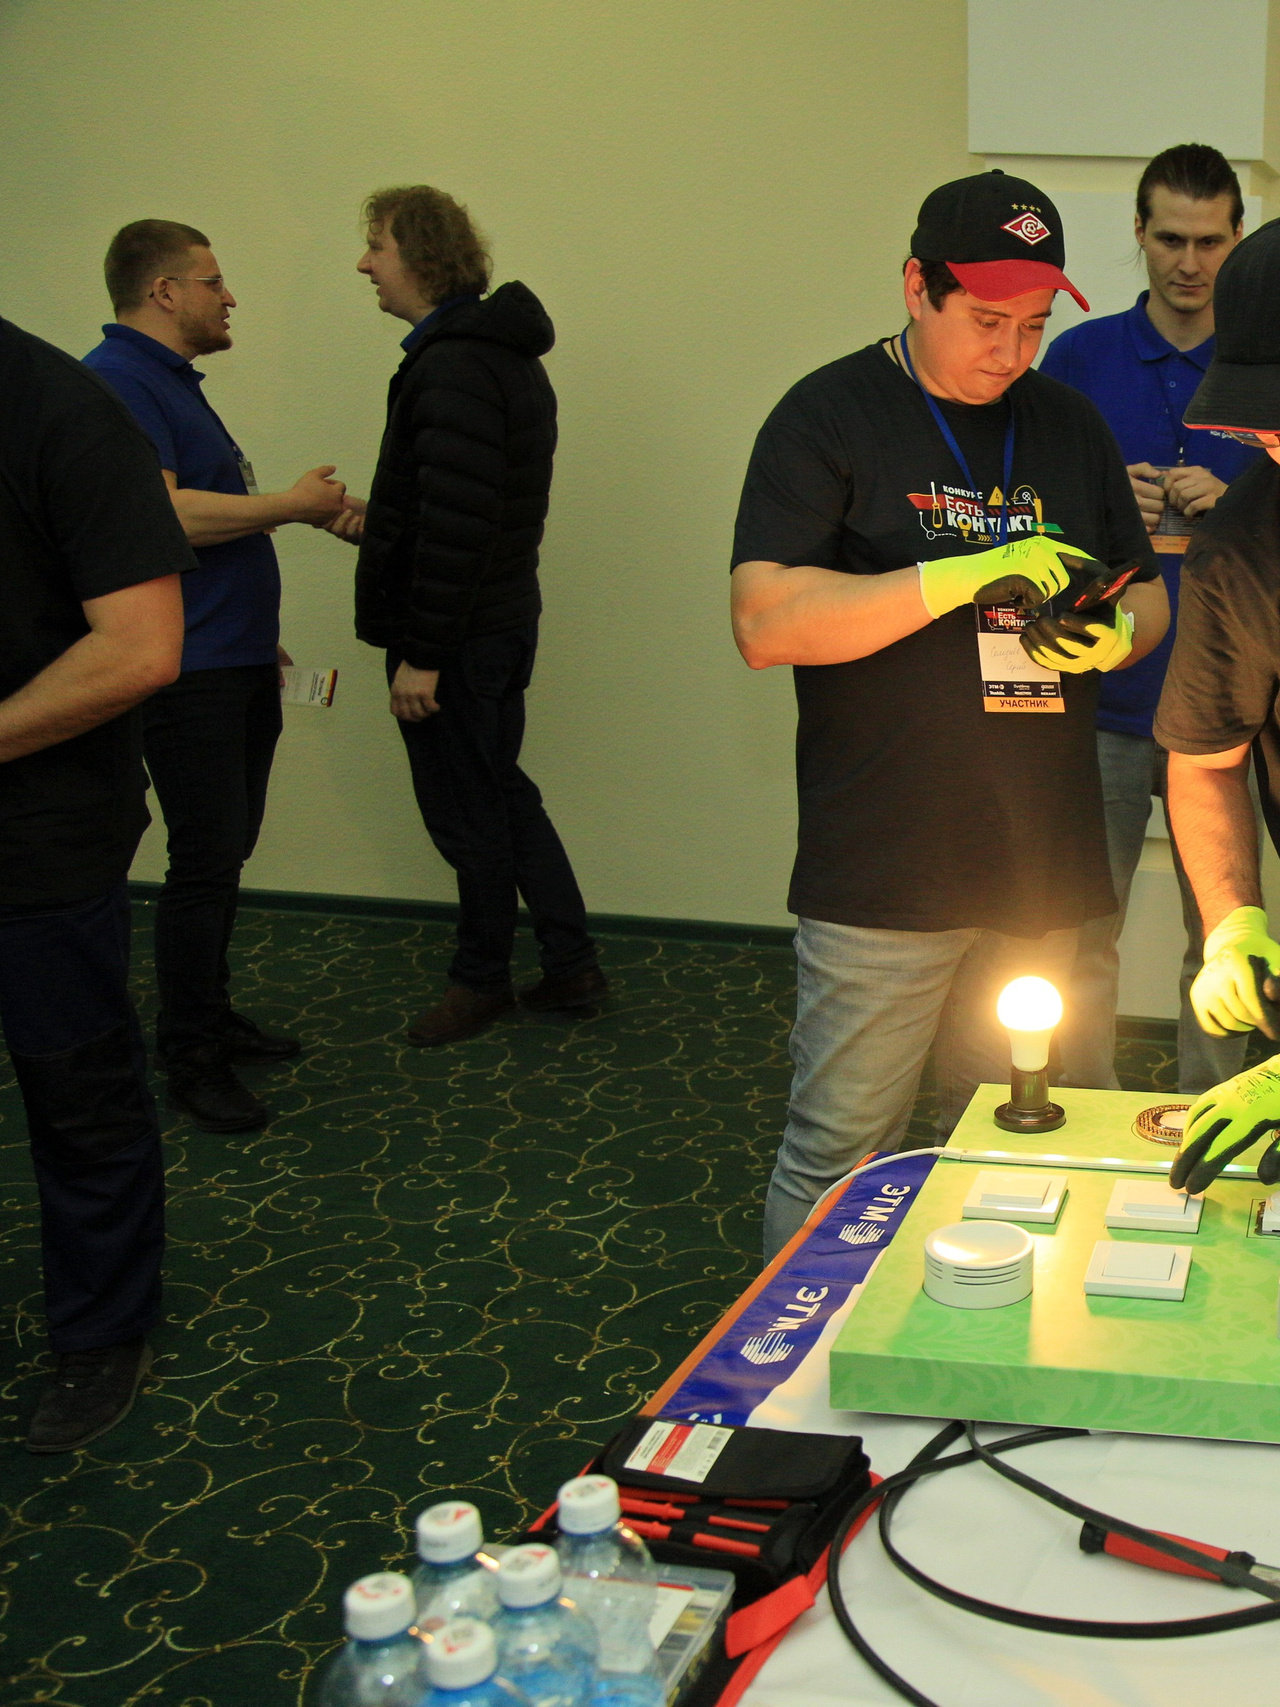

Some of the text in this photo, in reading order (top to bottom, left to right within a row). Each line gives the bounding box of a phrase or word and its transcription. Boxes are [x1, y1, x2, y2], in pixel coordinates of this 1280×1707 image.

[946, 510, 1033, 534] КОНТКТ
[998, 619, 1035, 627] КОНТА
[999, 699, 1049, 708] УЧАСТНИК
[858, 1183, 911, 1222] ЭТМ
[768, 1286, 829, 1333] ЭТМ
